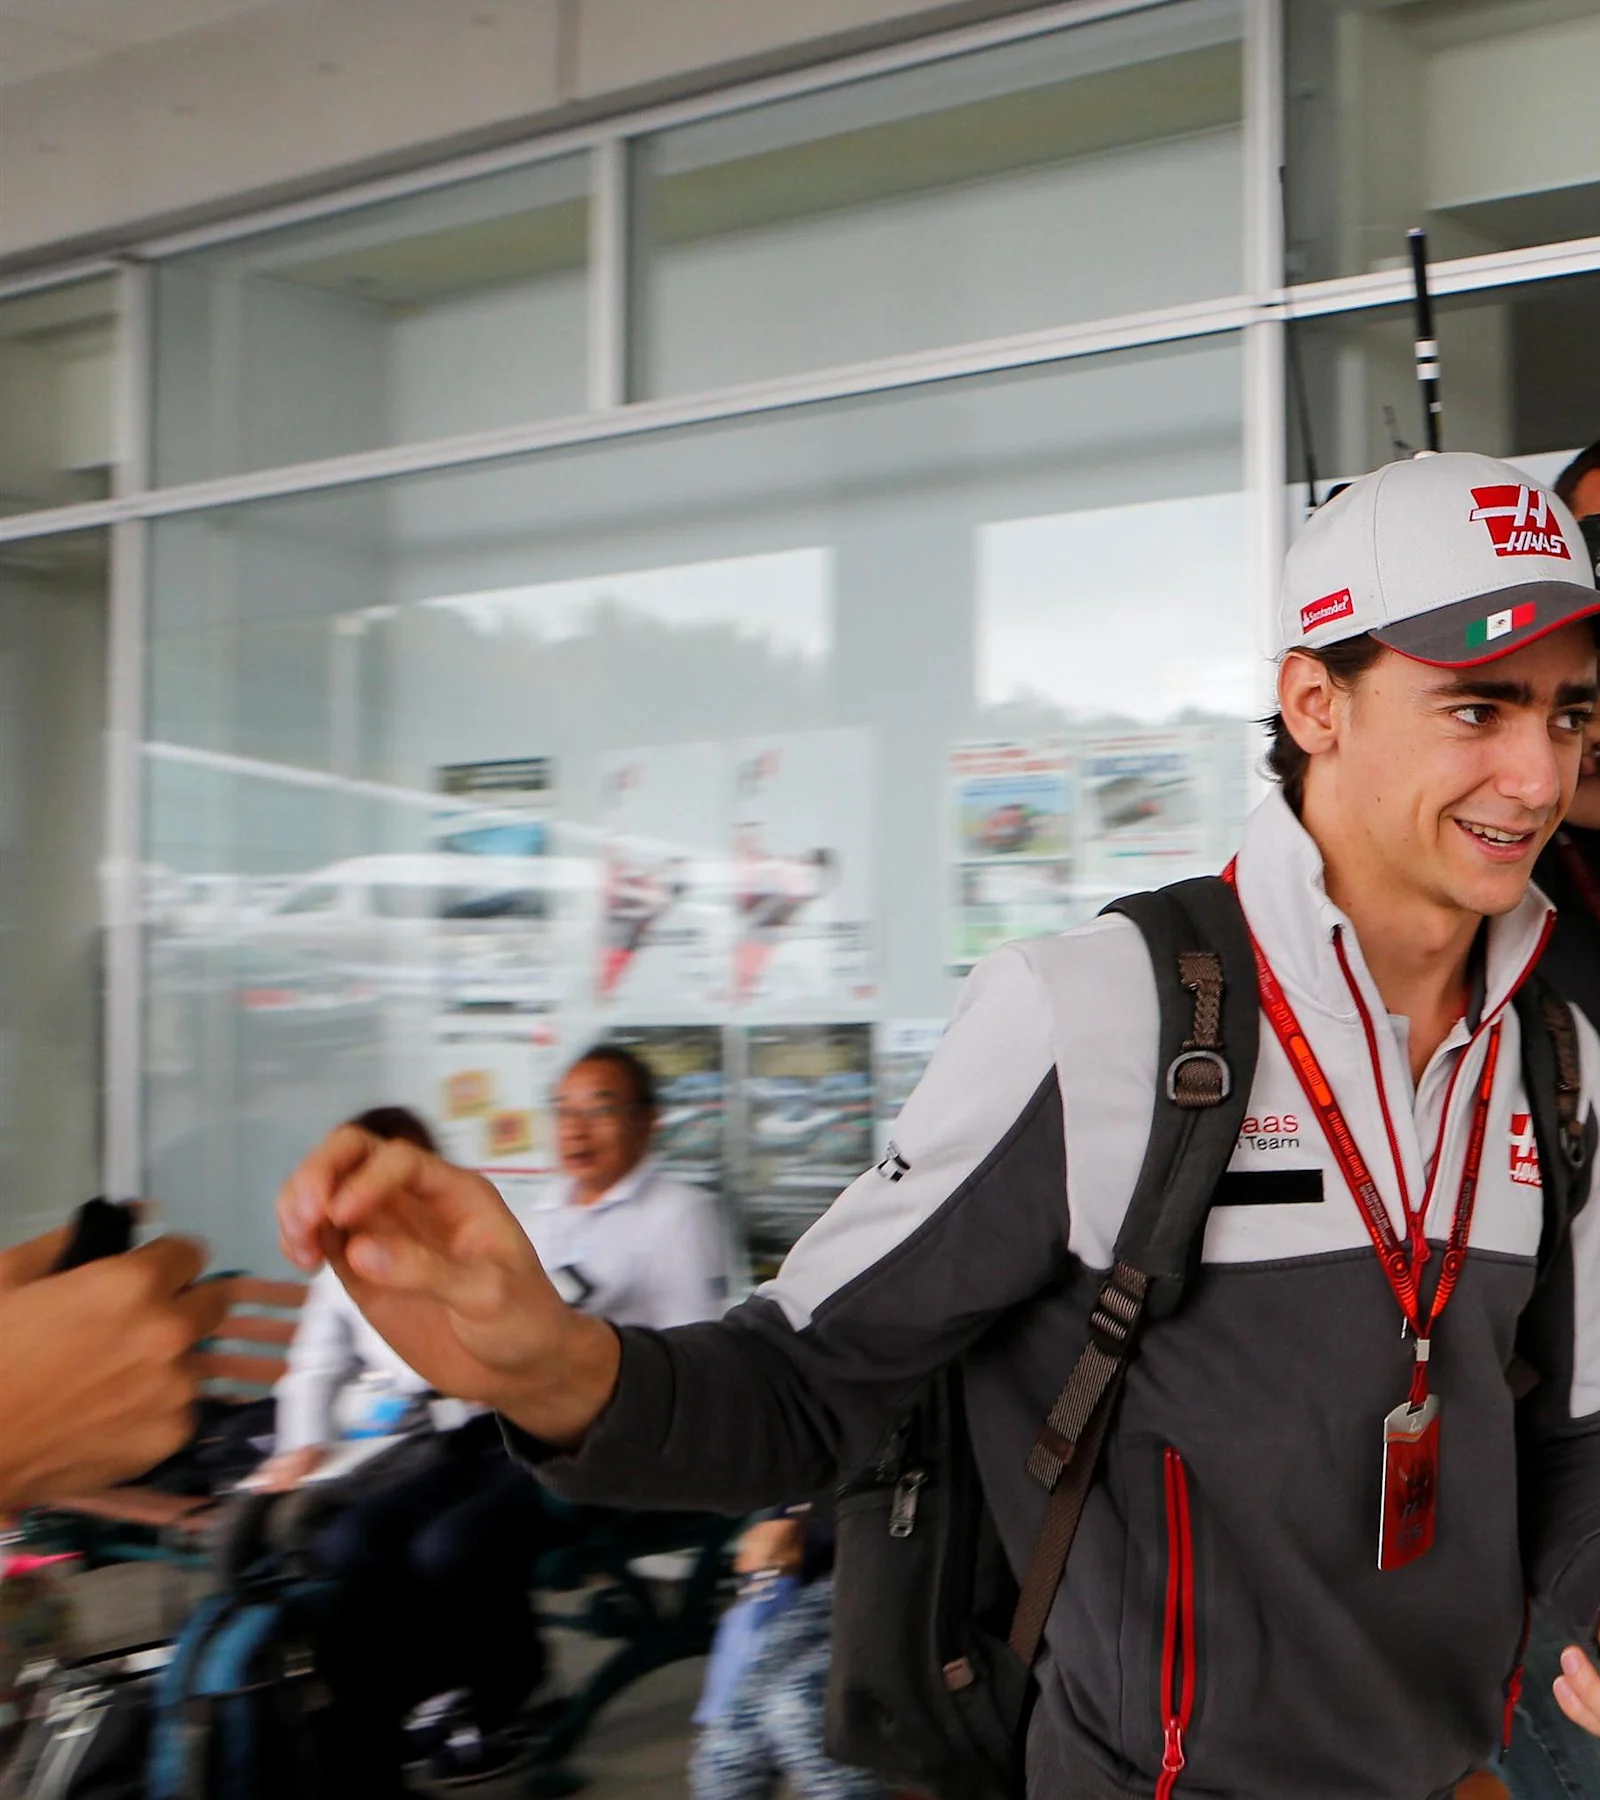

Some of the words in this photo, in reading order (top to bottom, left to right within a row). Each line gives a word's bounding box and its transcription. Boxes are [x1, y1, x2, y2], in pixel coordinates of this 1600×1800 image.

[1496, 531, 1563, 555] HAAS
[1308, 600, 1347, 622] Santander
[1241, 1113, 1299, 1134] aas
[1245, 1135, 1300, 1151] Team
